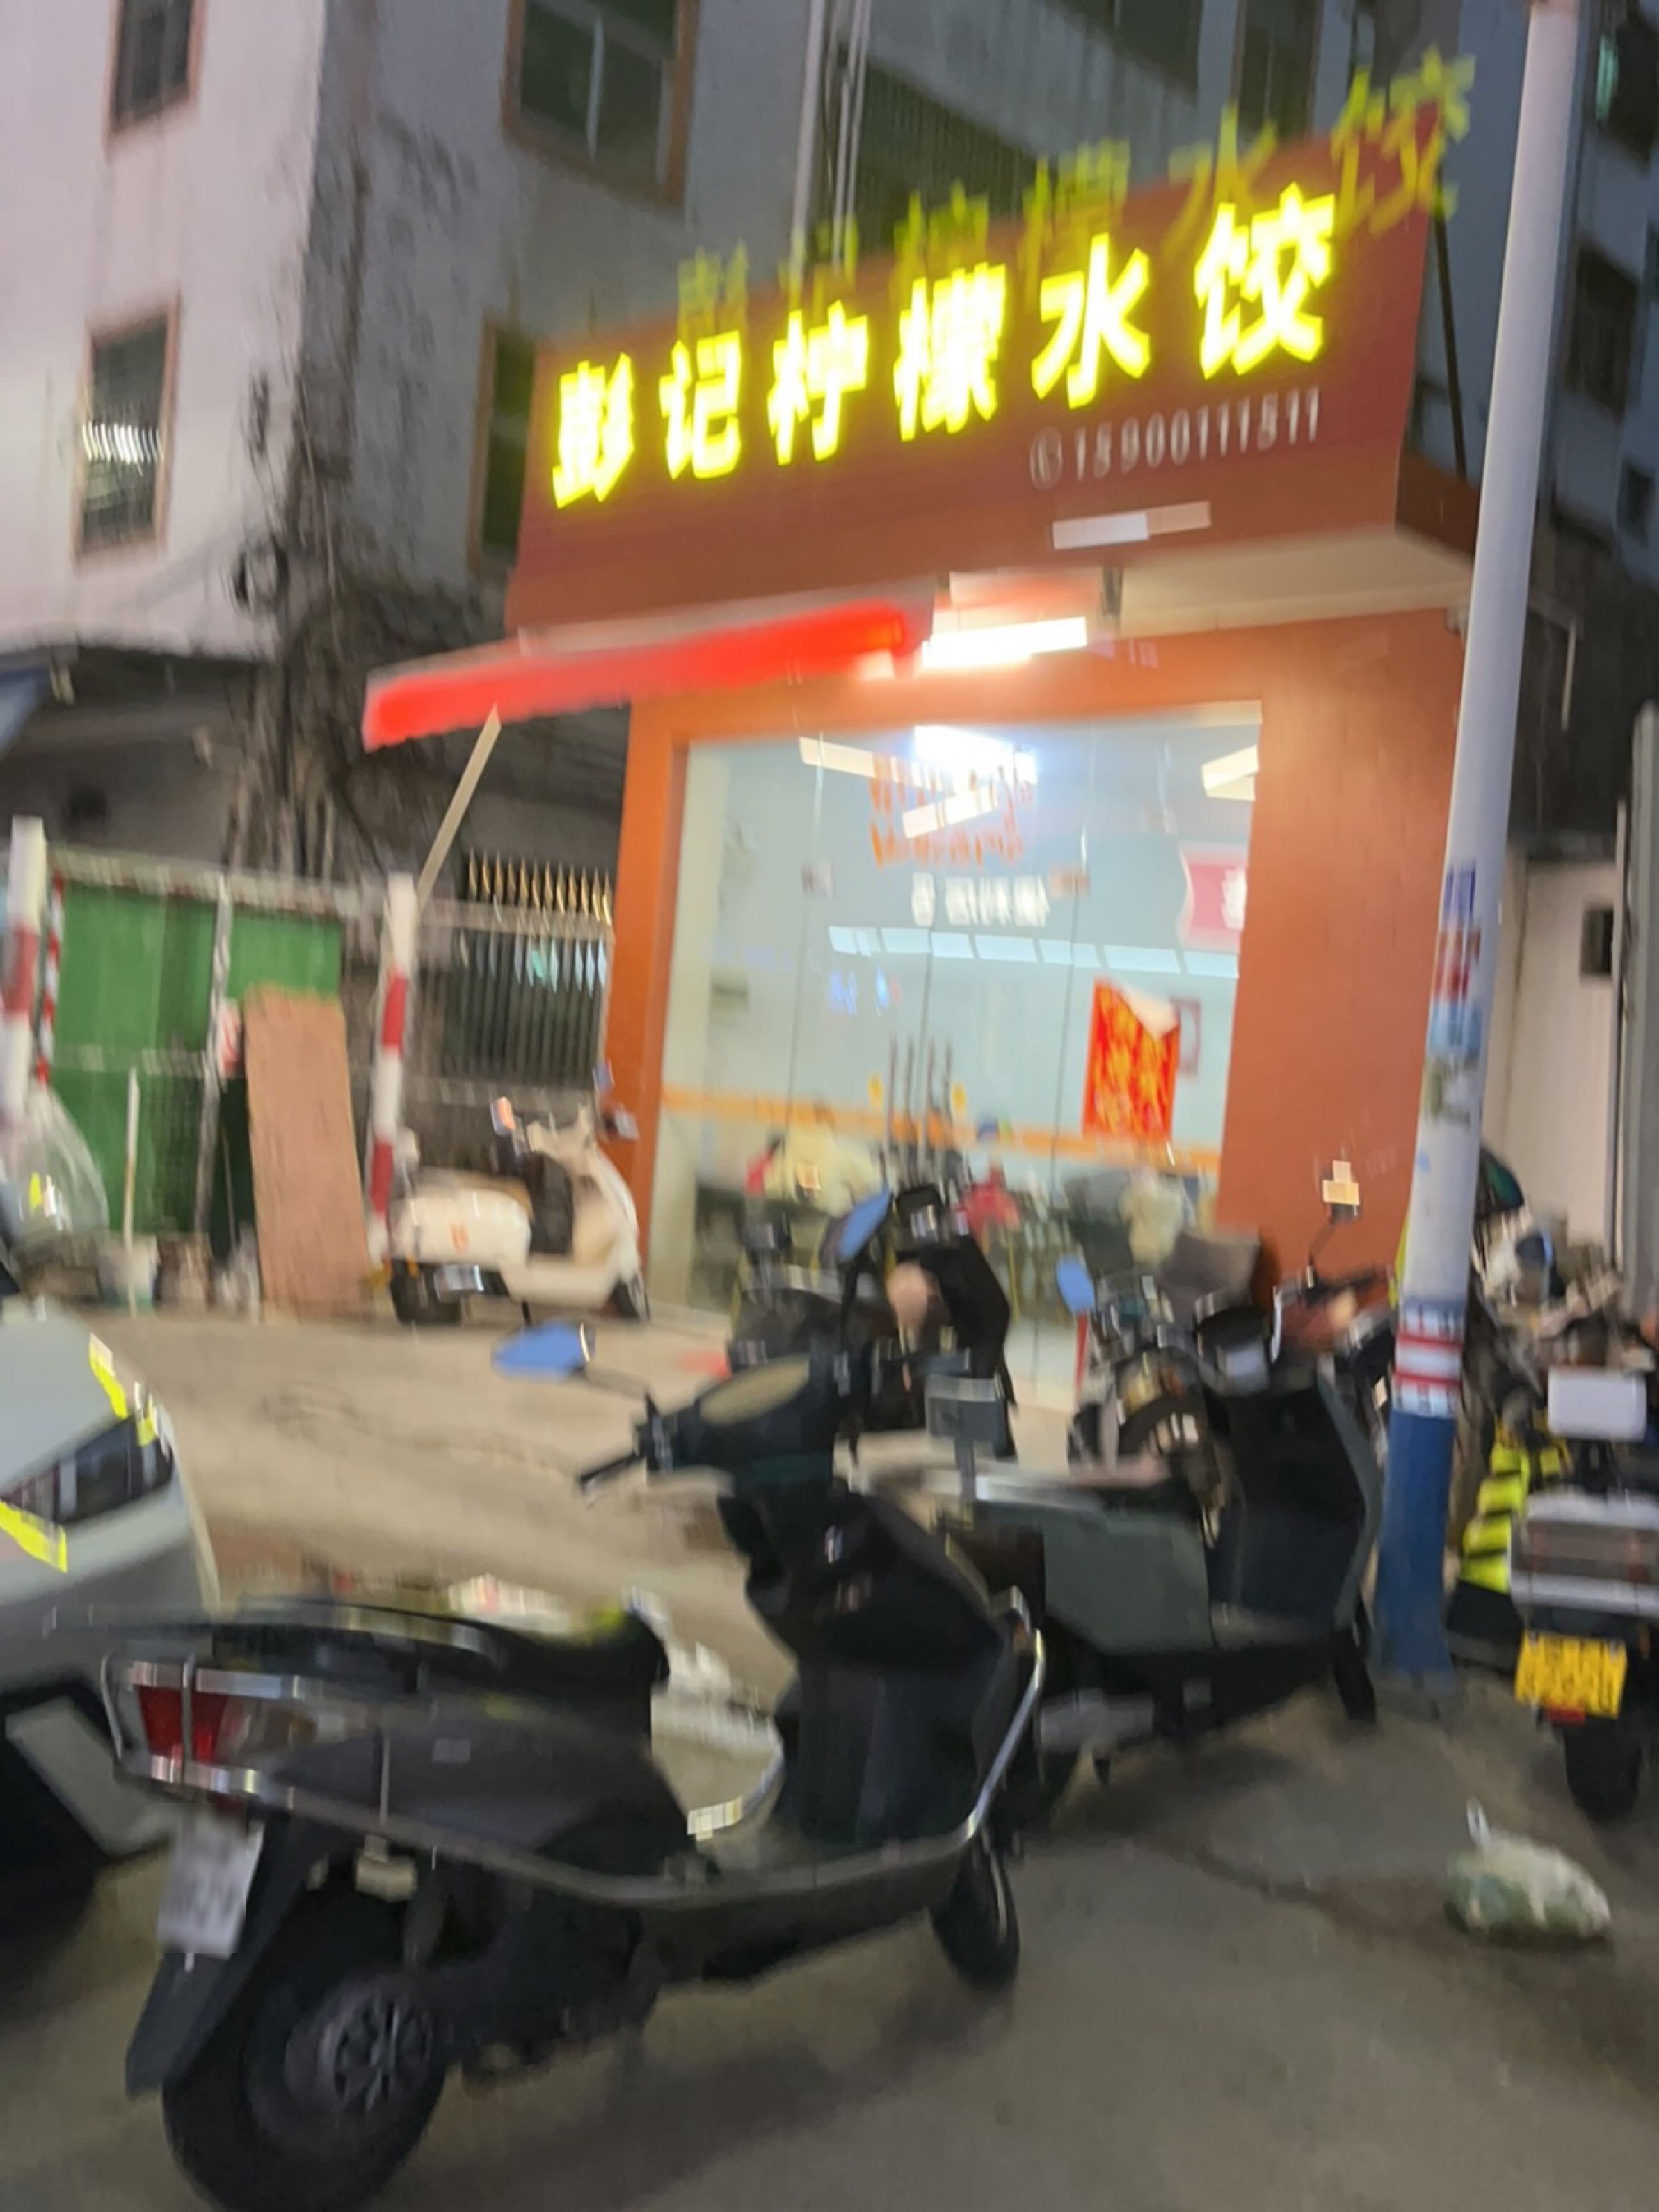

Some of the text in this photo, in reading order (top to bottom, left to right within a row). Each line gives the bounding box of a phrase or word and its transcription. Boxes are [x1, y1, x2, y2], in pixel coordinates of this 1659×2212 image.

[553, 183, 1335, 507] 彭记柠檬水饺
